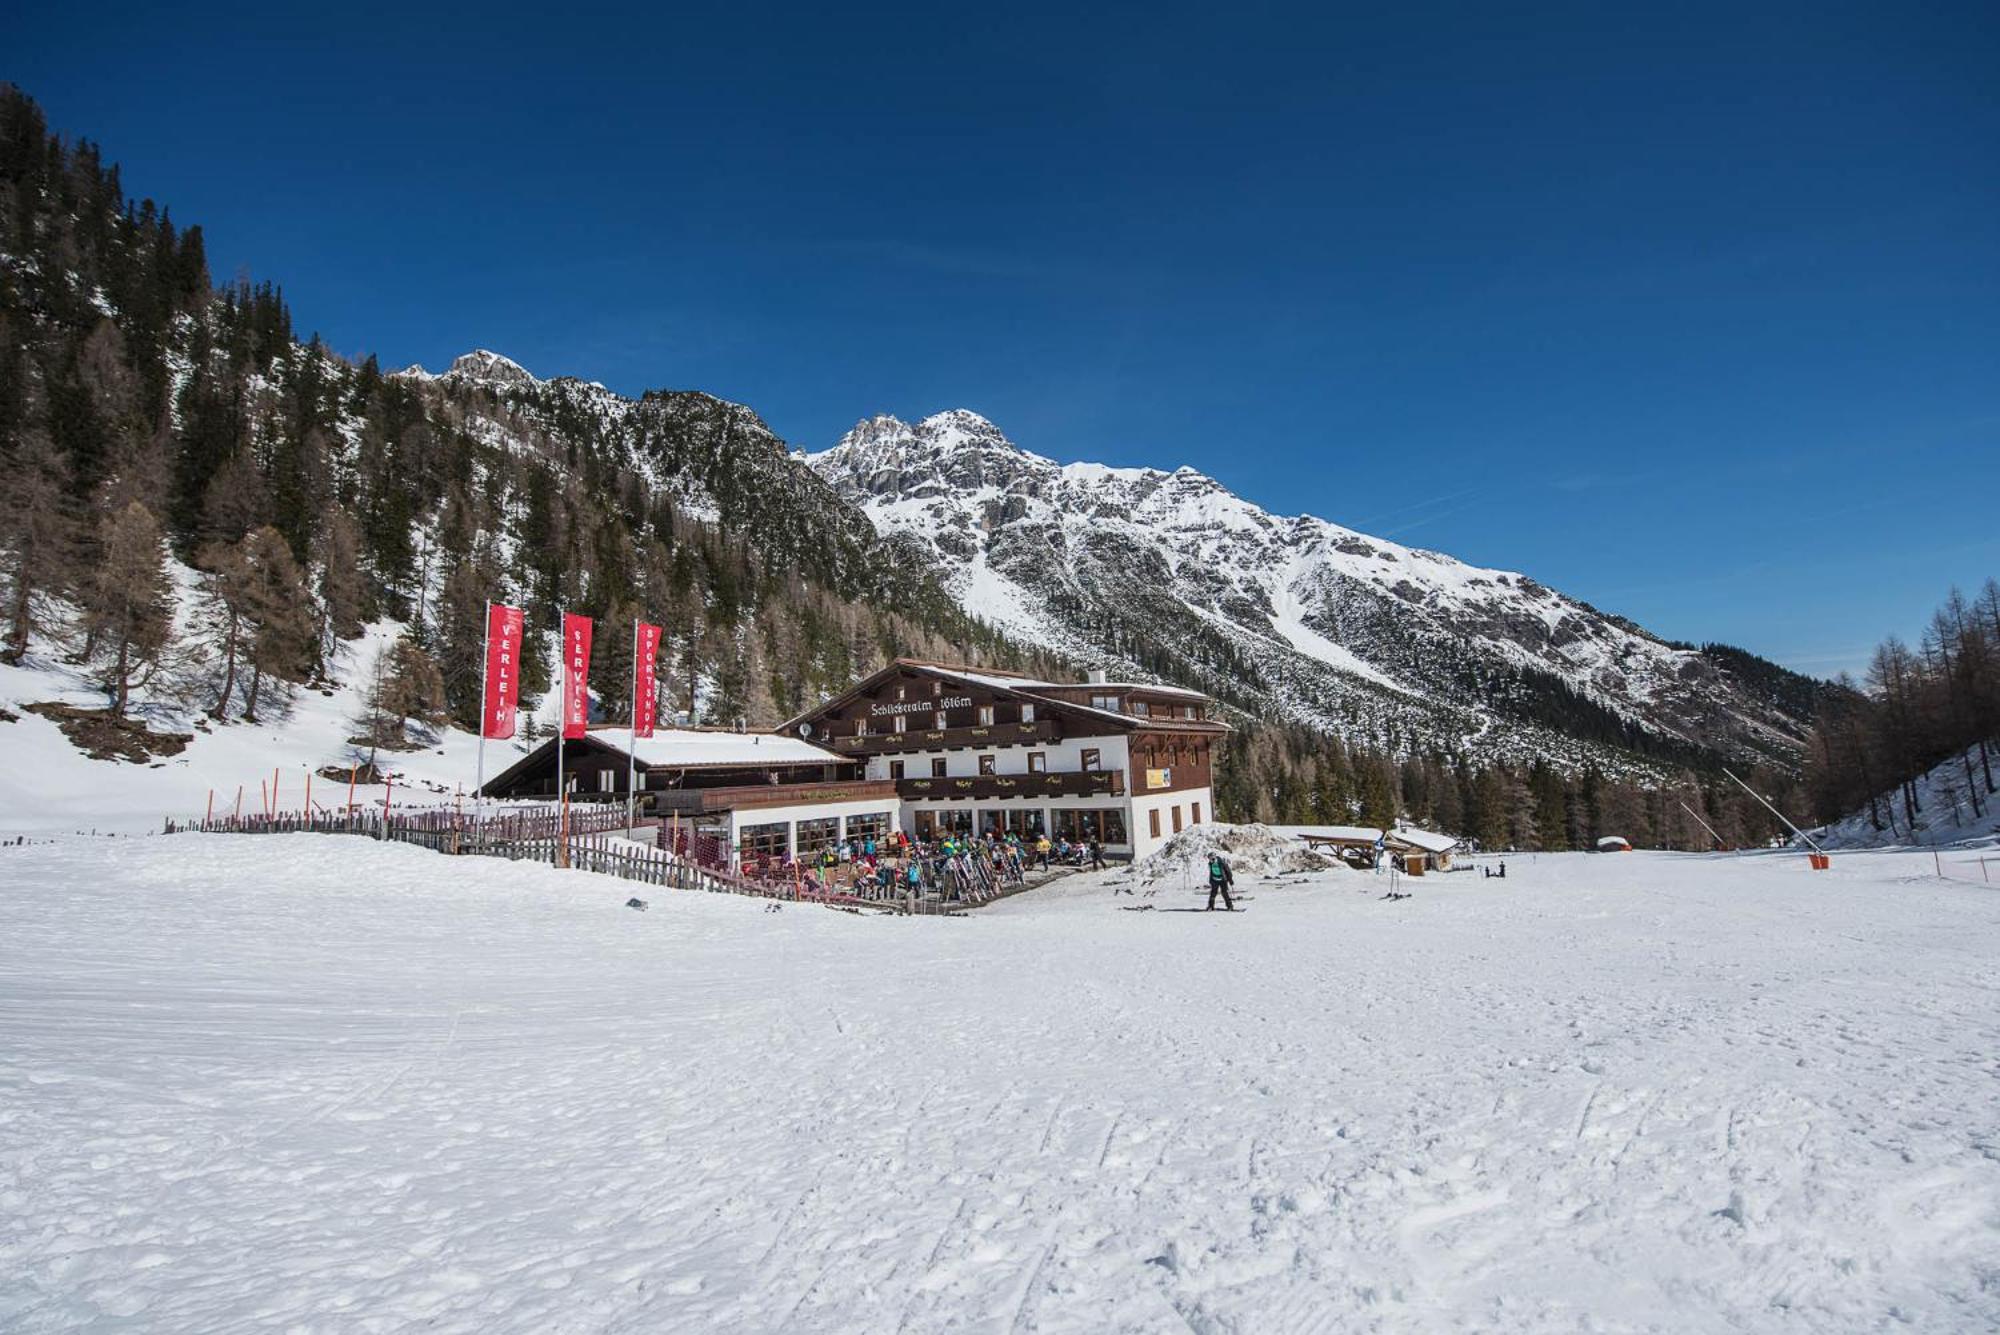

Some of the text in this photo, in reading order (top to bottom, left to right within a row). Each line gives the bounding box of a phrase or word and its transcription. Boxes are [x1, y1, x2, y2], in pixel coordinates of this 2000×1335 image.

[496, 624, 511, 722] VERLEIH
[573, 630, 584, 723] SERVICE
[643, 629, 653, 737] SPORTSHOP
[871, 702, 933, 716] Schlickeralm
